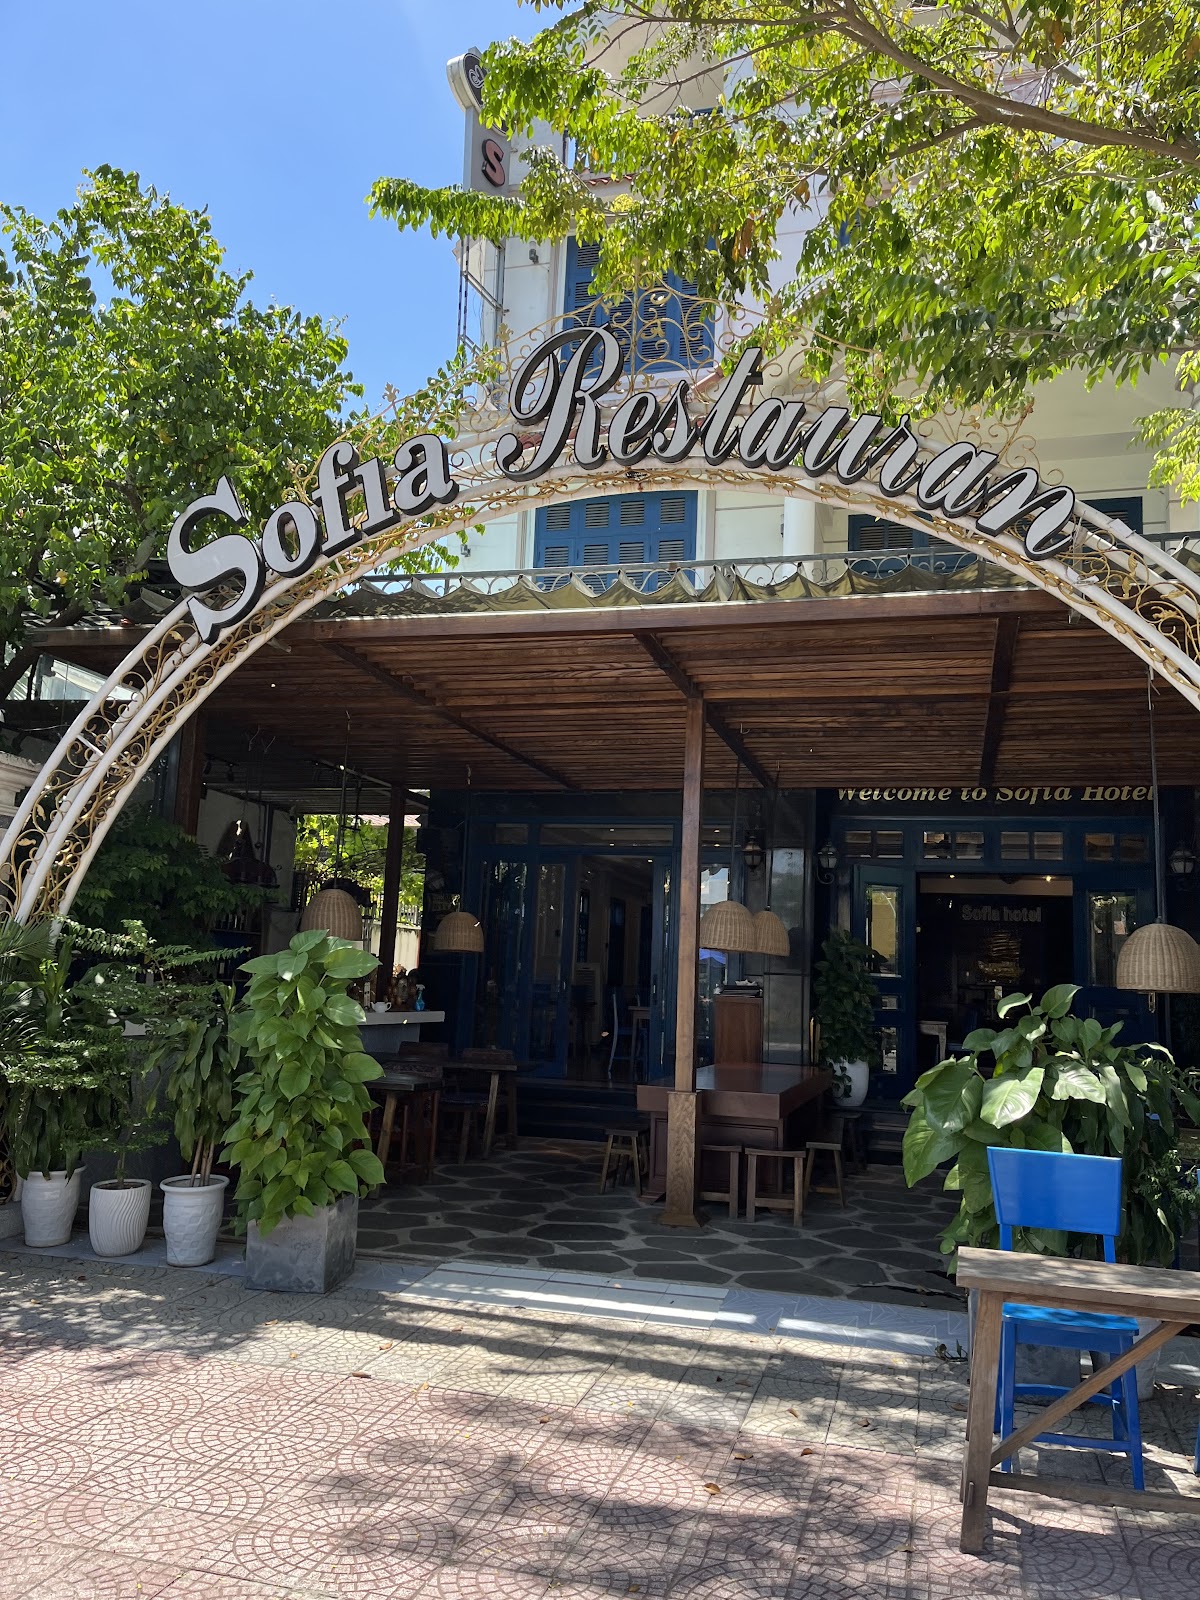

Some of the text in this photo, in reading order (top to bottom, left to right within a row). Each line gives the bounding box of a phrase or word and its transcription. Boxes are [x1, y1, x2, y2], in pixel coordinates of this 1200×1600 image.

[166, 322, 1077, 645] Sofia Restauran
[838, 787, 952, 801] Welcome
[960, 787, 987, 801] to
[995, 786, 1072, 805] Sofia
